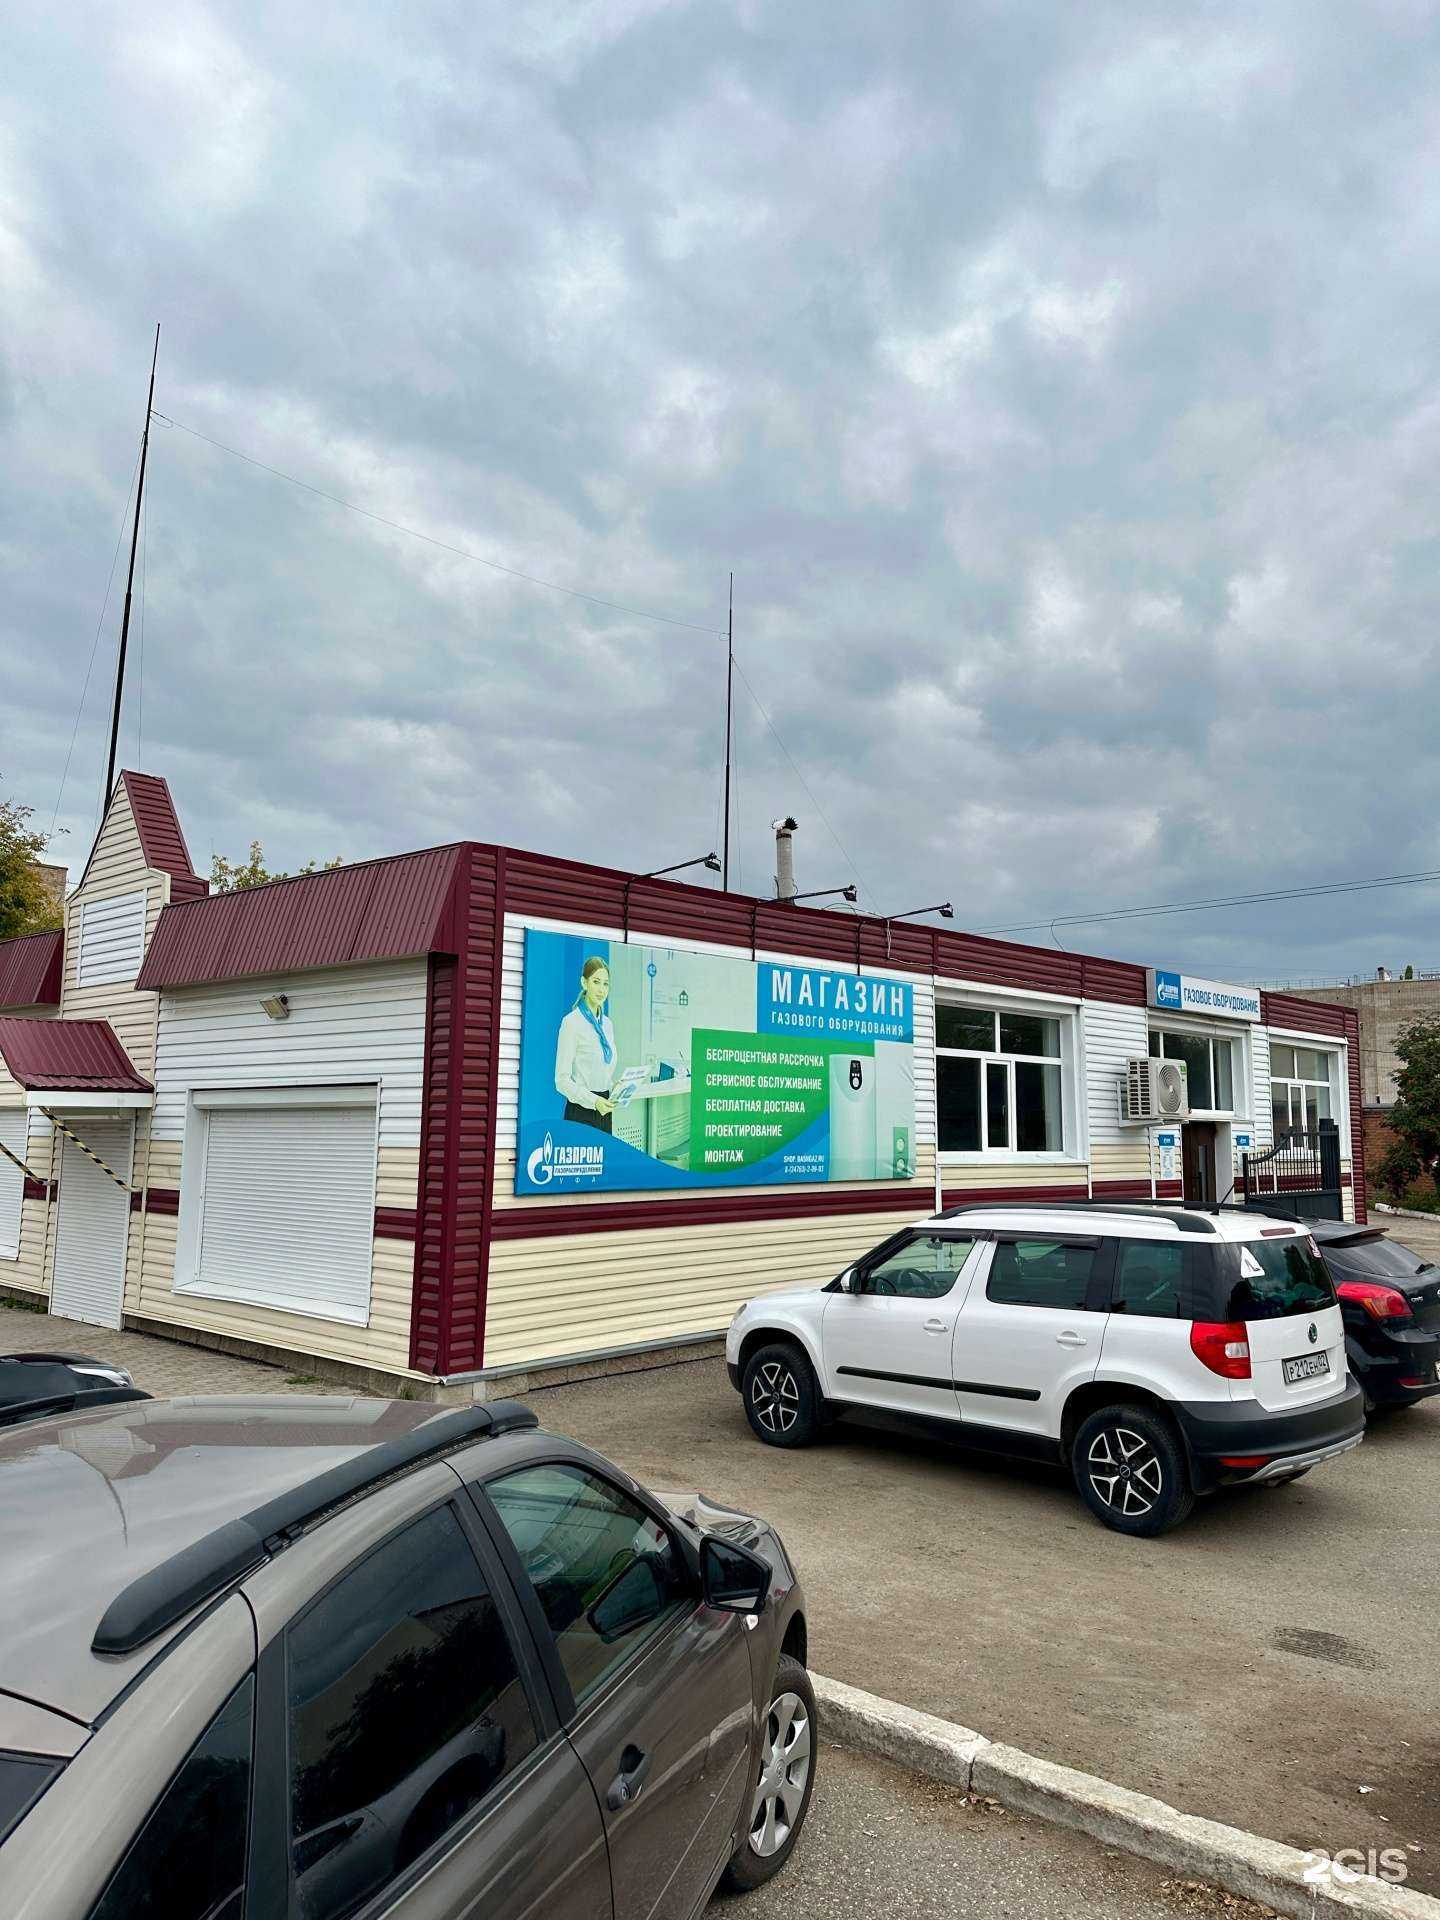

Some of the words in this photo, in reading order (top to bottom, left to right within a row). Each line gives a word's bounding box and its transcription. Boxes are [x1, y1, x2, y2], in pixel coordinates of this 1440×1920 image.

[771, 969, 904, 1017] МАГАЗИН
[1183, 987, 1212, 1006] ГАЗОВОЕ
[1212, 993, 1259, 1014] ОБОРУДОВАНИЕ
[770, 1011, 825, 1029] ГАЗОВОГО
[828, 1018, 904, 1037] ОБОРУДОВАНИЯ
[706, 1048, 778, 1064] БЕСПРОЦЕНТНАЯ
[779, 1053, 824, 1067] РАССРОЧКА
[706, 1073, 756, 1087] СЕРВИСНОЕ
[758, 1075, 823, 1090] ОБСЛУЖИВАНИЕ
[705, 1098, 762, 1112] БЕСПЛАТНАЯ
[763, 1100, 806, 1114] ДОСТАВКА
[705, 1124, 783, 1137] ПРОЕКТИРОВАНИЕ
[553, 1146, 604, 1164] ГАЗПРОМ
[704, 1149, 744, 1163] МОНТАЖ
